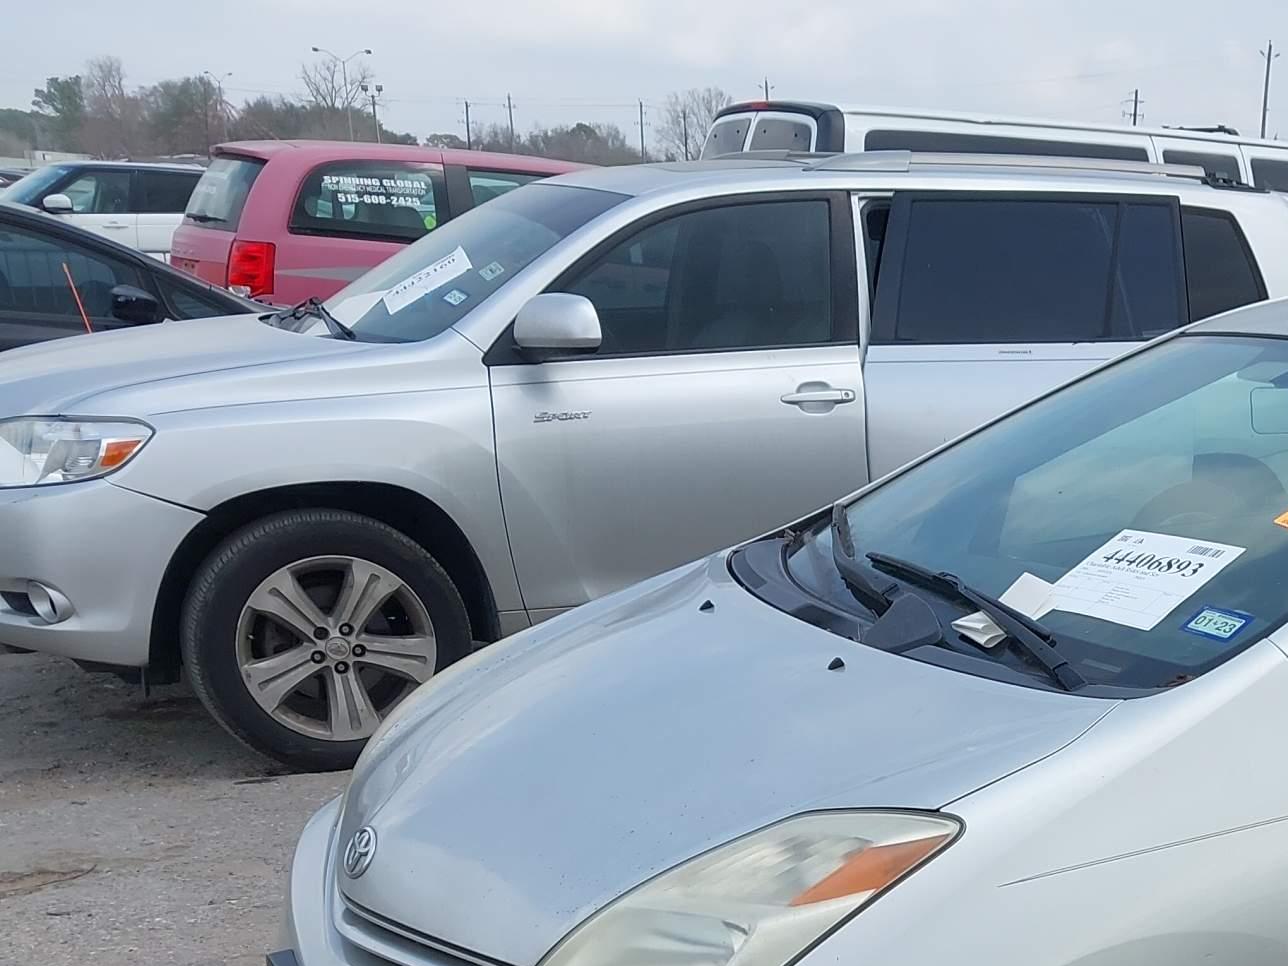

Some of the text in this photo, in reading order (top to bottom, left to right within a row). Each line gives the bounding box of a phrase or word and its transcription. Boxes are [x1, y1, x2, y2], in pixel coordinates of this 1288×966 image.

[382, 178, 427, 189] GLOBAL
[1103, 549, 1205, 578] 44406893
[1194, 615, 1214, 628] 01
[1215, 621, 1237, 634] 23
